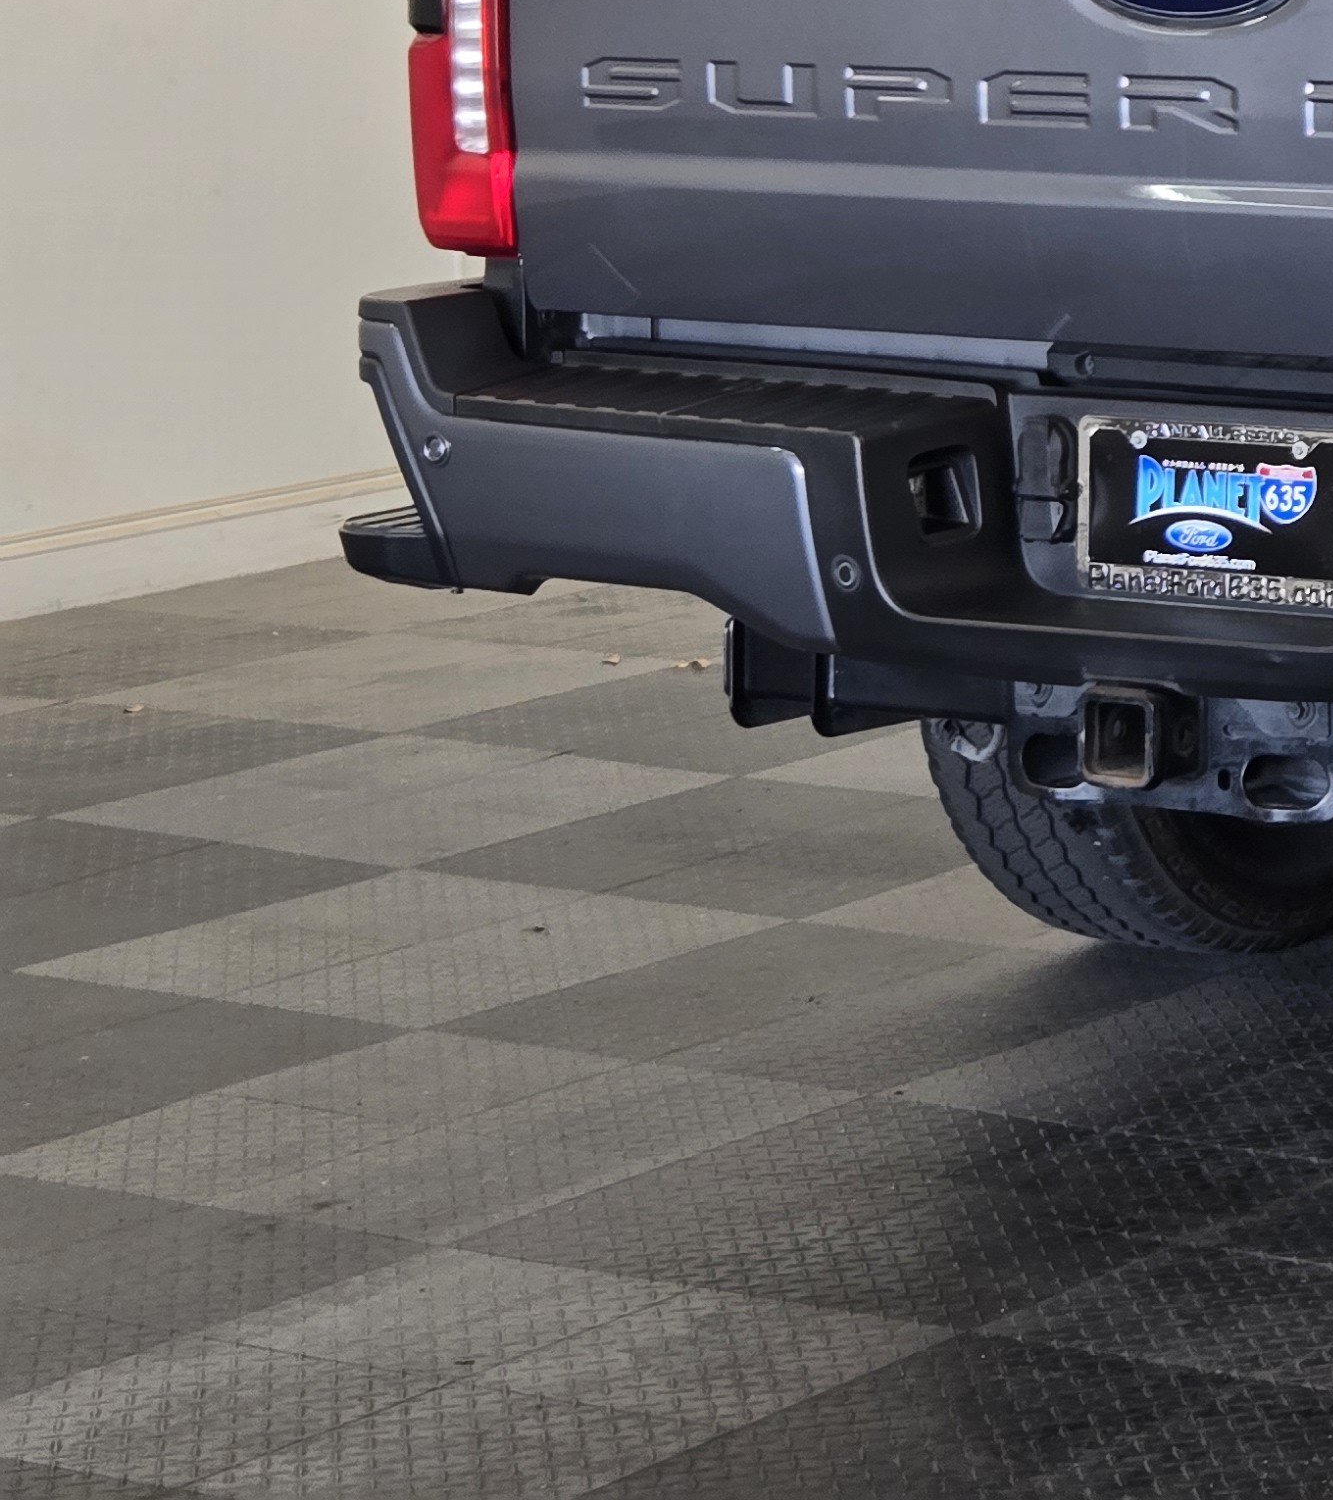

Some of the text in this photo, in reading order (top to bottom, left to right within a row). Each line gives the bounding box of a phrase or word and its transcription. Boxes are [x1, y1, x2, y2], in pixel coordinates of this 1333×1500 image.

[581, 56, 1242, 137] SUPER
[1137, 454, 1265, 525] PLANET
[1264, 484, 1307, 513] 635
[1178, 524, 1220, 548] Ford
